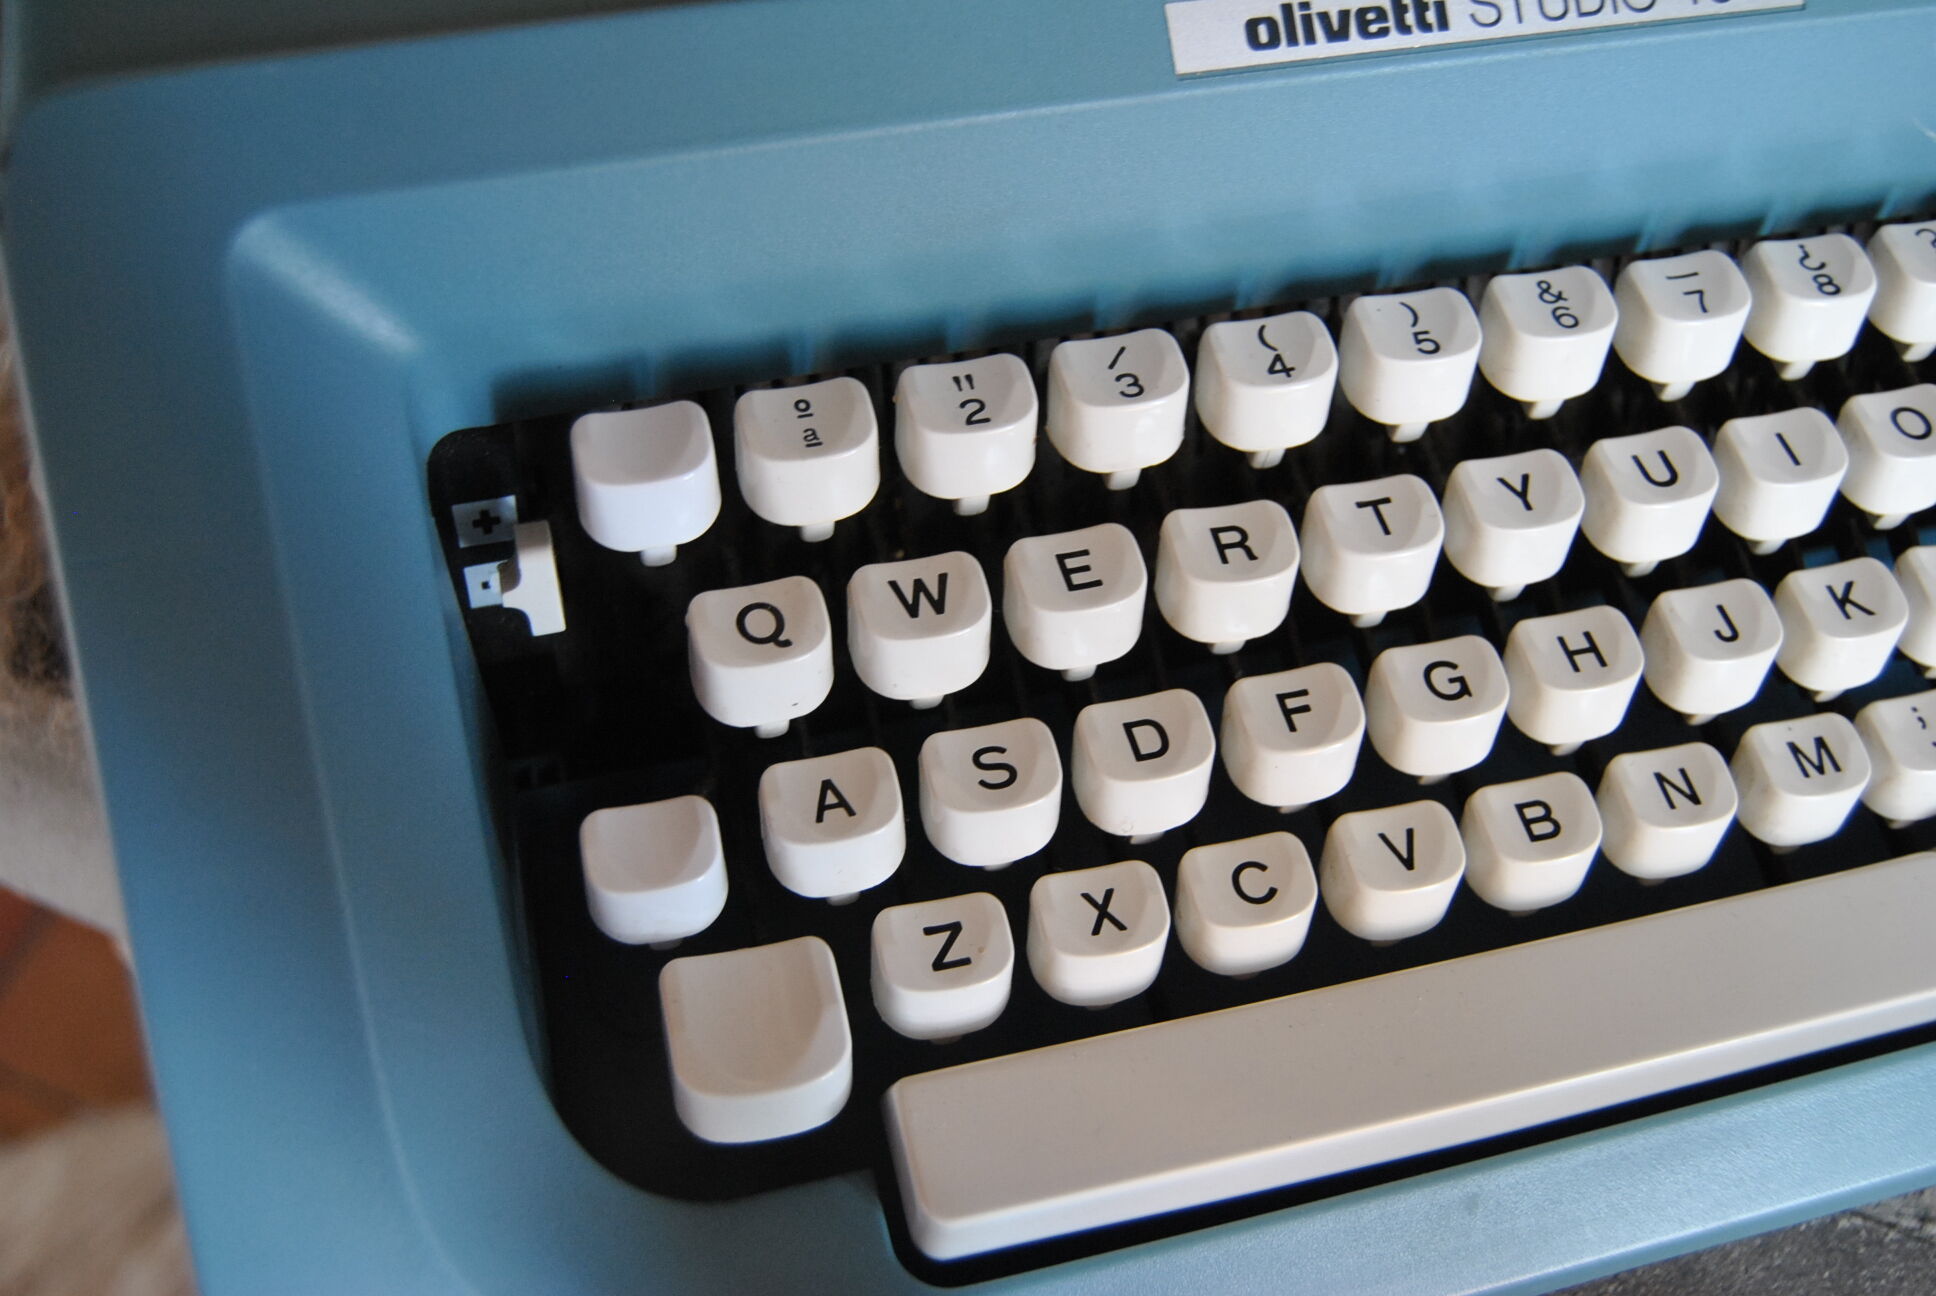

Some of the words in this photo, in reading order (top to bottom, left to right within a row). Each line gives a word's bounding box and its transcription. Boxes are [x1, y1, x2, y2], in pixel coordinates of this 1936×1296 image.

[1244, 0, 1450, 51] olivetti
[1536, 280, 1568, 304] &
[1683, 290, 1708, 313] 7
[1813, 274, 1842, 296] 8
[1400, 302, 1419, 327] )
[1551, 306, 1579, 329] 6
[1258, 325, 1278, 351] (
[1412, 330, 1441, 355] 5
[1108, 346, 1126, 370] /
[1267, 353, 1296, 378] 4
[1115, 373, 1144, 398] 3
[959, 399, 991, 426] 2
[1890, 407, 1933, 440] O
[1631, 450, 1679, 487] U
[1775, 433, 1801, 466] I
[1497, 473, 1533, 511] Y
[1355, 497, 1392, 535] T
[1209, 525, 1258, 564] R
[1055, 549, 1103, 592] E
[887, 572, 948, 618] W
[1826, 581, 1876, 620] K
[736, 602, 792, 648] Q
[1714, 604, 1739, 643] J
[1557, 631, 1608, 673] H
[1423, 661, 1472, 701] G
[1275, 689, 1311, 732] F
[1122, 719, 1169, 762] D
[1786, 736, 1842, 778] M
[972, 746, 1017, 790] S
[816, 779, 856, 823] A
[1654, 768, 1702, 810] N
[1514, 800, 1561, 842] B
[1378, 828, 1415, 871] V
[1232, 861, 1278, 905] C
[1080, 888, 1128, 936] X
[923, 921, 972, 972] Z
